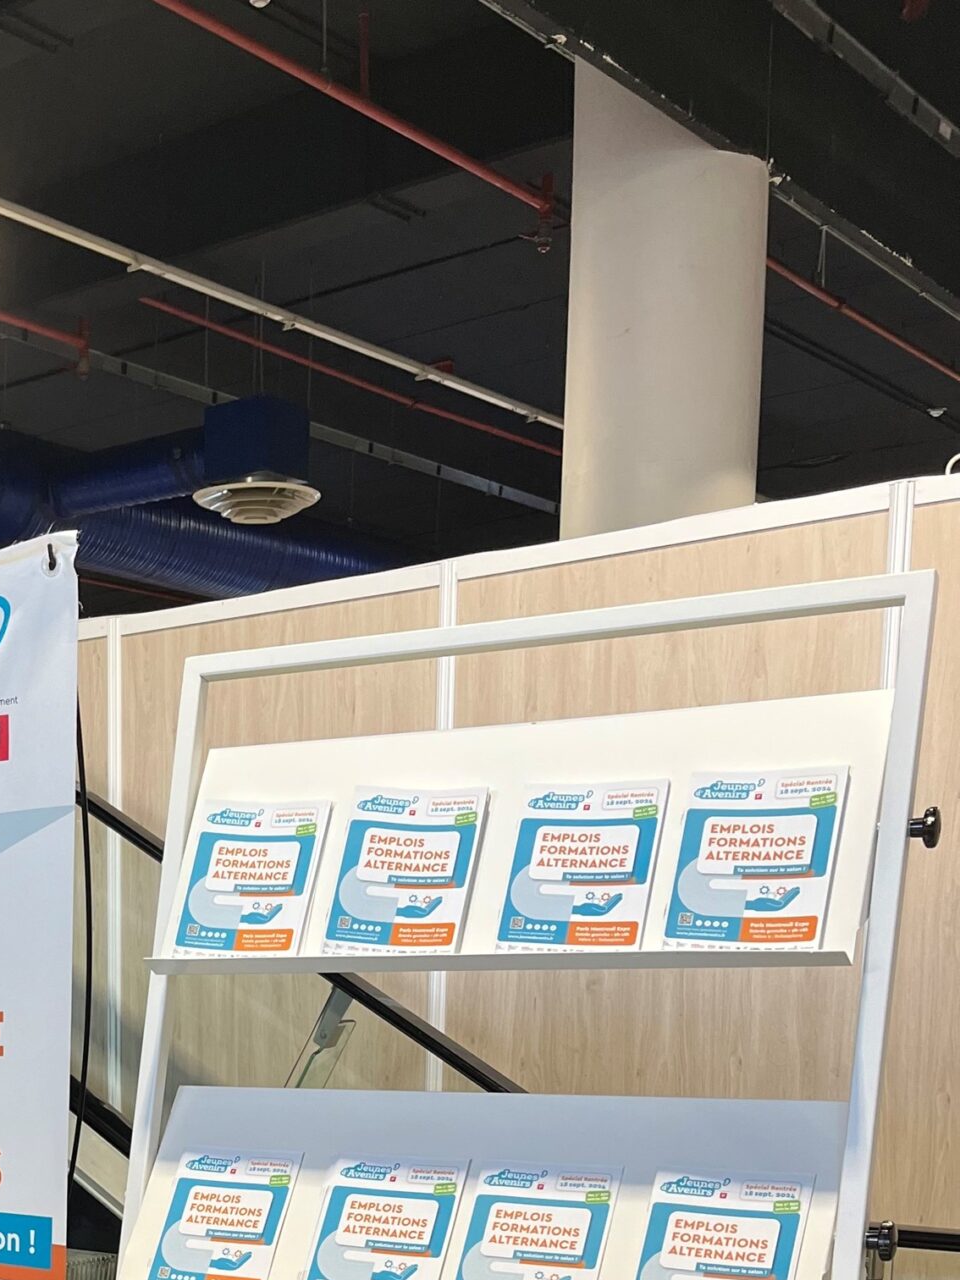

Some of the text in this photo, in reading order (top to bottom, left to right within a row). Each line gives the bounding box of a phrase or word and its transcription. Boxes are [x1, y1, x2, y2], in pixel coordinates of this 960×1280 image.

[713, 781, 755, 790] Jeunes
[374, 795, 411, 806] Jeunes
[545, 793, 584, 801] Jeunes
[222, 809, 257, 818] Jeunes
[710, 823, 775, 834] EMPLOIS
[369, 834, 425, 848] EMPLOIS
[541, 832, 601, 842] EMPLOIS
[707, 835, 806, 847] FORMATIONS
[217, 846, 269, 857] EMPLOIS
[366, 846, 450, 862] FORMATIONS
[539, 845, 629, 854] FORMATIONS
[704, 849, 804, 861] ALTERNANCE
[214, 858, 291, 870] FORMATIONS
[363, 859, 447, 874] ALTERNANCE
[536, 857, 627, 867] ALTERNANCE
[211, 869, 288, 881] ALTERNANCE
[201, 1155, 233, 1165] Jeunes
[356, 1163, 392, 1172] Jeunes
[501, 1170, 539, 1180] Jeunes
[679, 1177, 721, 1188] Jeunes
[192, 1191, 242, 1204] EMPLOIS
[189, 1202, 263, 1217] FORMATIONS
[349, 1200, 404, 1213] EMPLOIS
[185, 1214, 259, 1229] ALTERNANCE
[346, 1212, 428, 1227] FORMATIONS
[494, 1209, 553, 1222] EMPLOIS
[491, 1221, 580, 1237] FORMATIONS
[673, 1218, 738, 1233] EMPLOIS
[342, 1224, 425, 1240] ALTERNANCE
[29, 1230, 36, 1255] !
[488, 1233, 577, 1250] ALTERNANCE
[671, 1231, 769, 1249] FORMATIONS
[667, 1244, 766, 1263] ALTERNANCE
